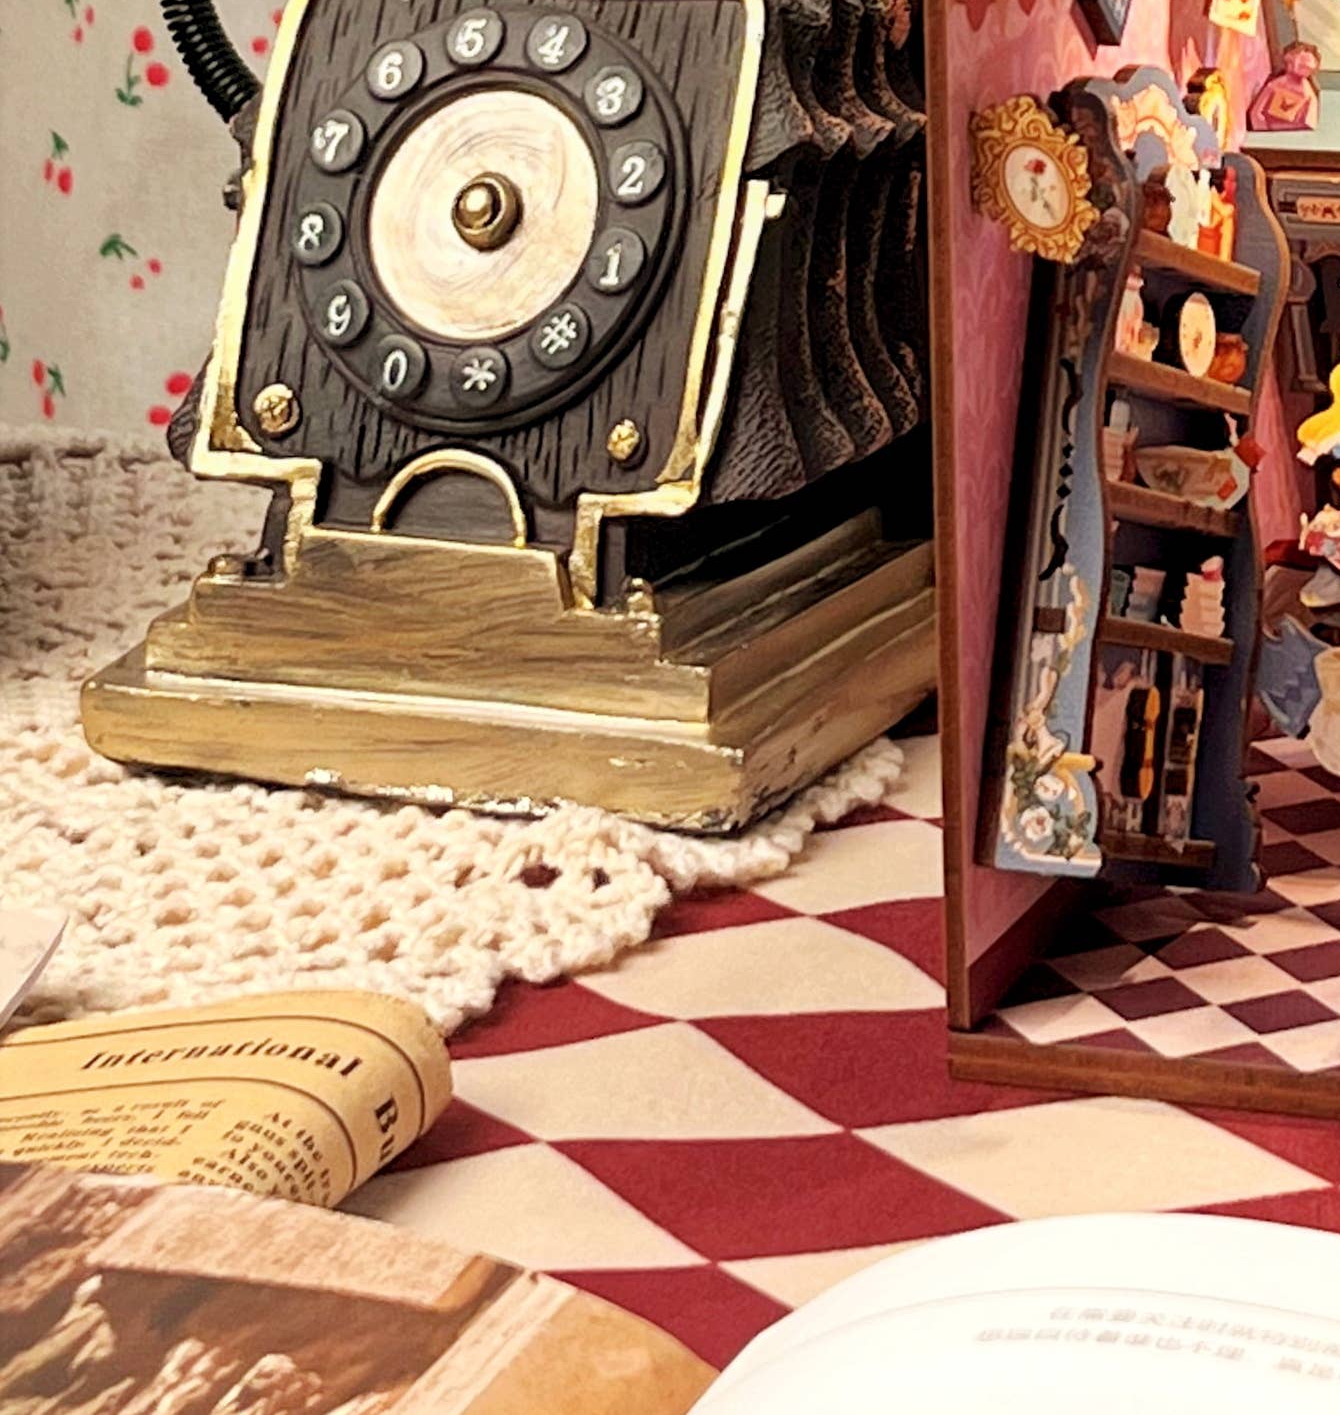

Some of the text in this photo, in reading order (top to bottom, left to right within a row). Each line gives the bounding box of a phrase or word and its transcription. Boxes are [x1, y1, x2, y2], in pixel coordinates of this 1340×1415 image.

[457, 19, 488, 54] 5
[538, 24, 573, 65] 4
[380, 52, 403, 90] 6
[596, 76, 627, 115] 3
[312, 119, 350, 161] 7
[617, 155, 645, 195] 2
[299, 213, 324, 251] 8
[601, 248, 621, 287] 1
[327, 295, 354, 333] 9
[82, 1037, 363, 1076] International
